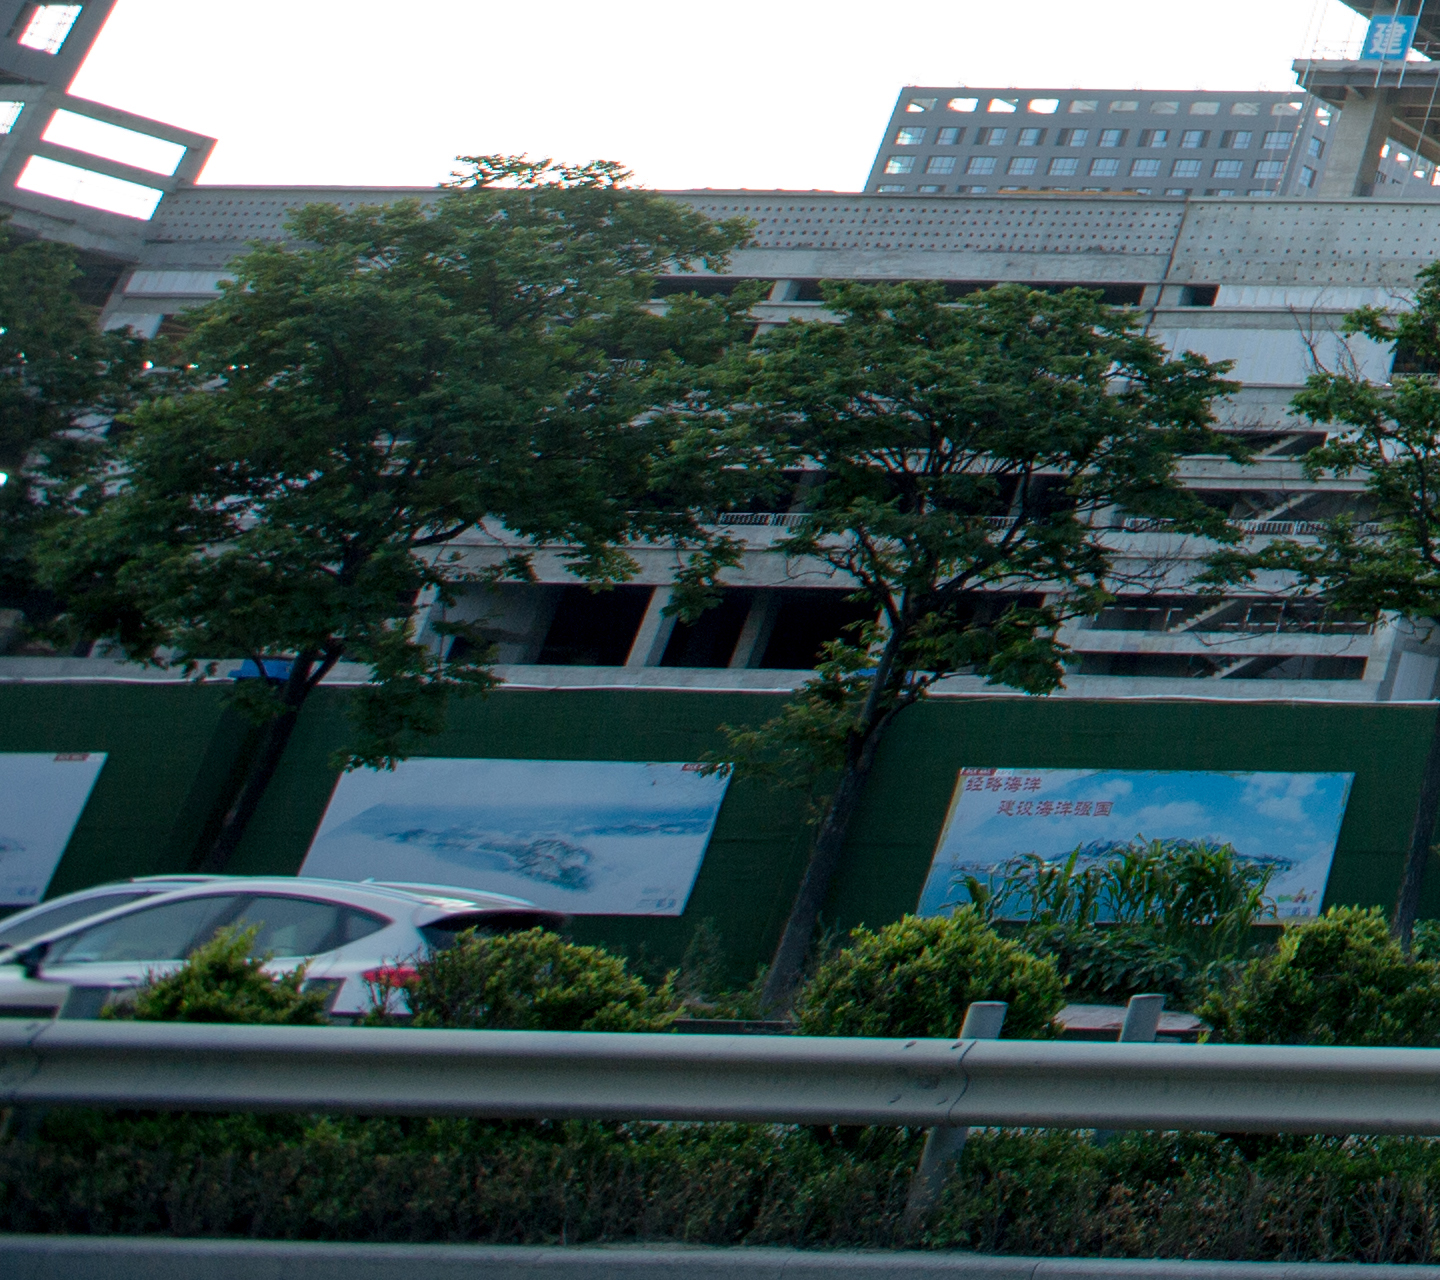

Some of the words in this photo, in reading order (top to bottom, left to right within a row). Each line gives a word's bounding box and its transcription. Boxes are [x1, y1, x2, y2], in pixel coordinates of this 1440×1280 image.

[966, 776, 1042, 792] 经略海洋
[996, 800, 1114, 817] 建设海洋强国
